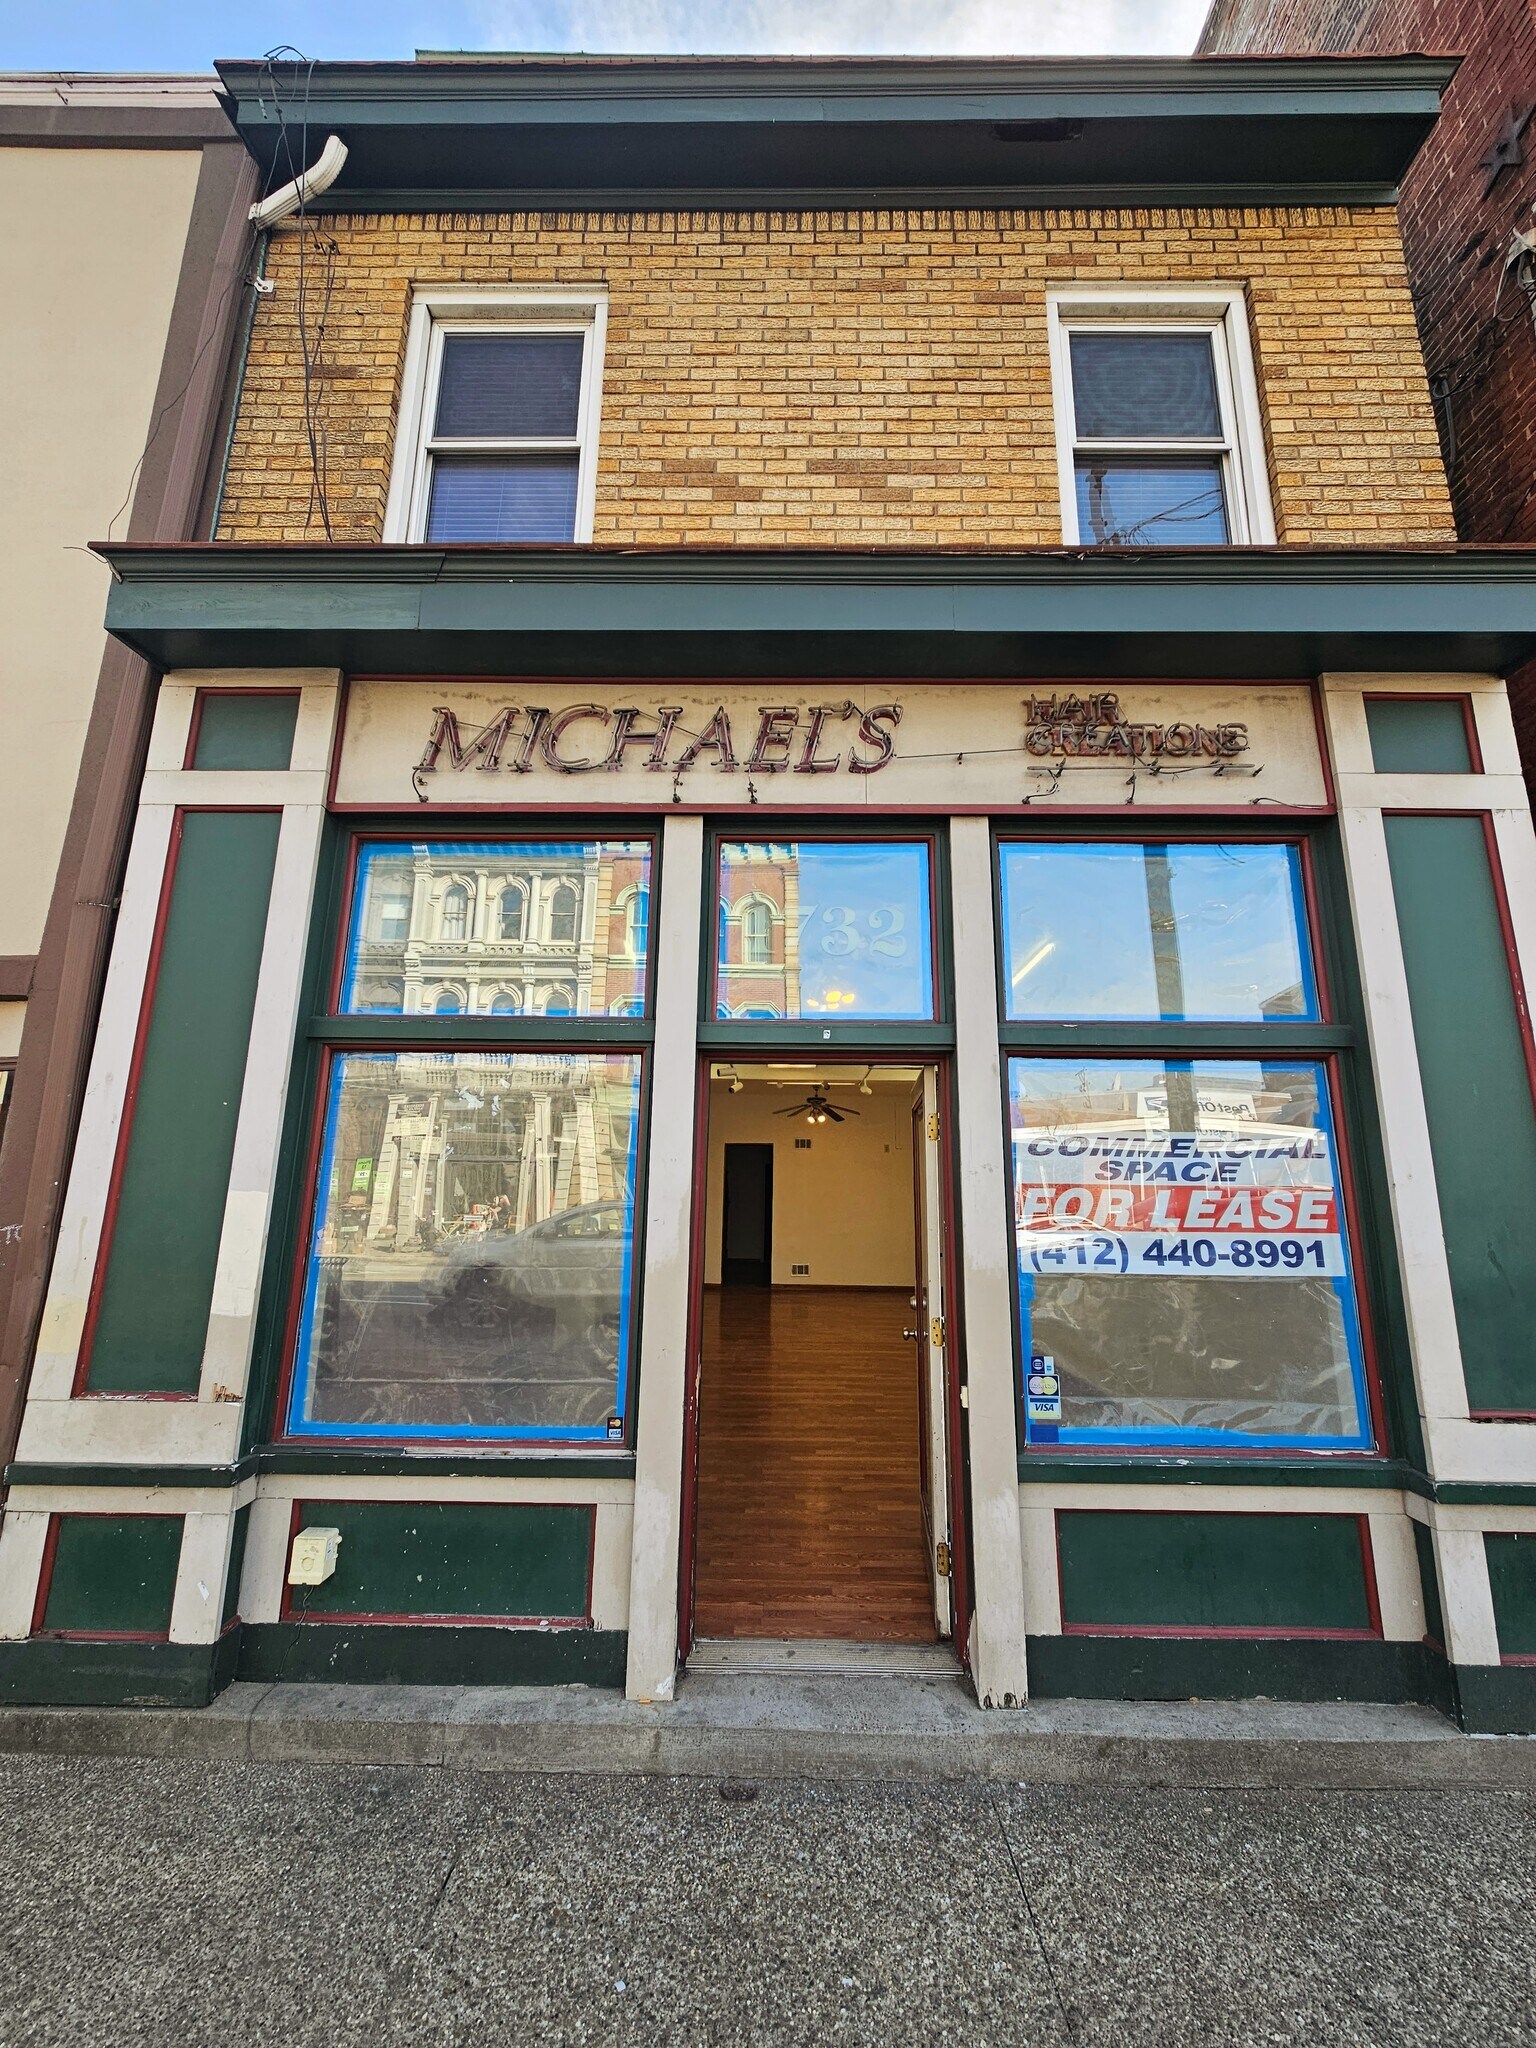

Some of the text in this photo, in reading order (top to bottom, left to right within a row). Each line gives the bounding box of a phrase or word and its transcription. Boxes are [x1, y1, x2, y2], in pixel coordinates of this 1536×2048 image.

[1023, 693, 1121, 726] HAIR
[413, 700, 904, 774] MICHAEL'S
[1025, 722, 1250, 757] CREATIONS
[1027, 1137, 1327, 1159] COMMERCIAL
[1094, 1161, 1241, 1182] SPACE
[1022, 1187, 1334, 1230] FOR LEASE
[1030, 1237, 1327, 1273] (412) 440-8991
[1034, 1403, 1054, 1412] VISA
